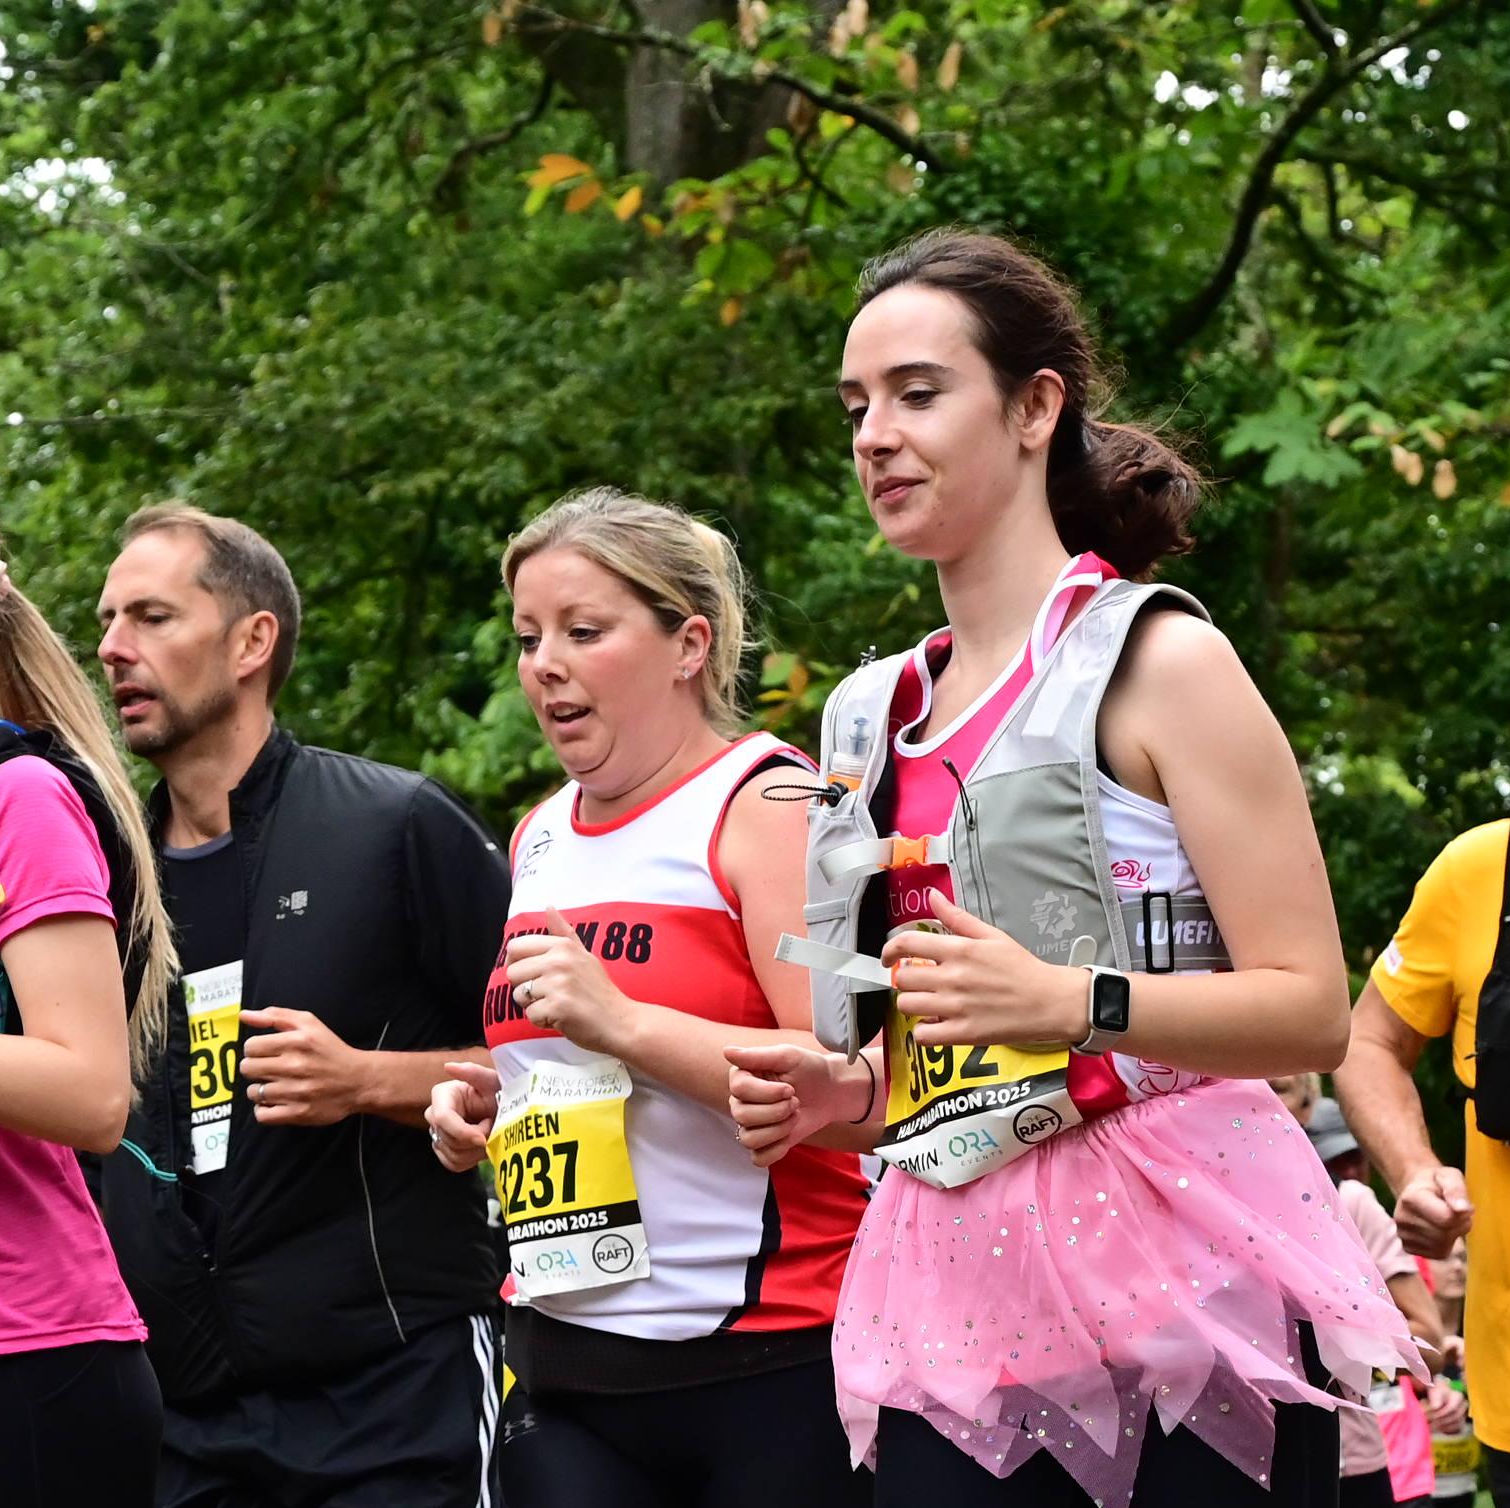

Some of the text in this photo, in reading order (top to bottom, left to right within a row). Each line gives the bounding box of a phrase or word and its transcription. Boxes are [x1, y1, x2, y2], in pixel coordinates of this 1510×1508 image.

[601, 921, 653, 964] 88
[485, 983, 527, 1028] RUN
[191, 1018, 219, 1043] IEL
[539, 1084, 622, 1097] MARATHON
[541, 1074, 574, 1088] NEW
[896, 1081, 1031, 1140] HALF MARATHON 2025
[504, 1112, 560, 1151] SHIREEN
[1019, 1116, 1056, 1138] RAFT
[948, 1129, 1000, 1157] ORA
[960, 1150, 1004, 1167] EVENTS
[508, 1211, 609, 1242] ARATHON 2025
[536, 1249, 578, 1271] ORA
[597, 1248, 629, 1263] RAFT
